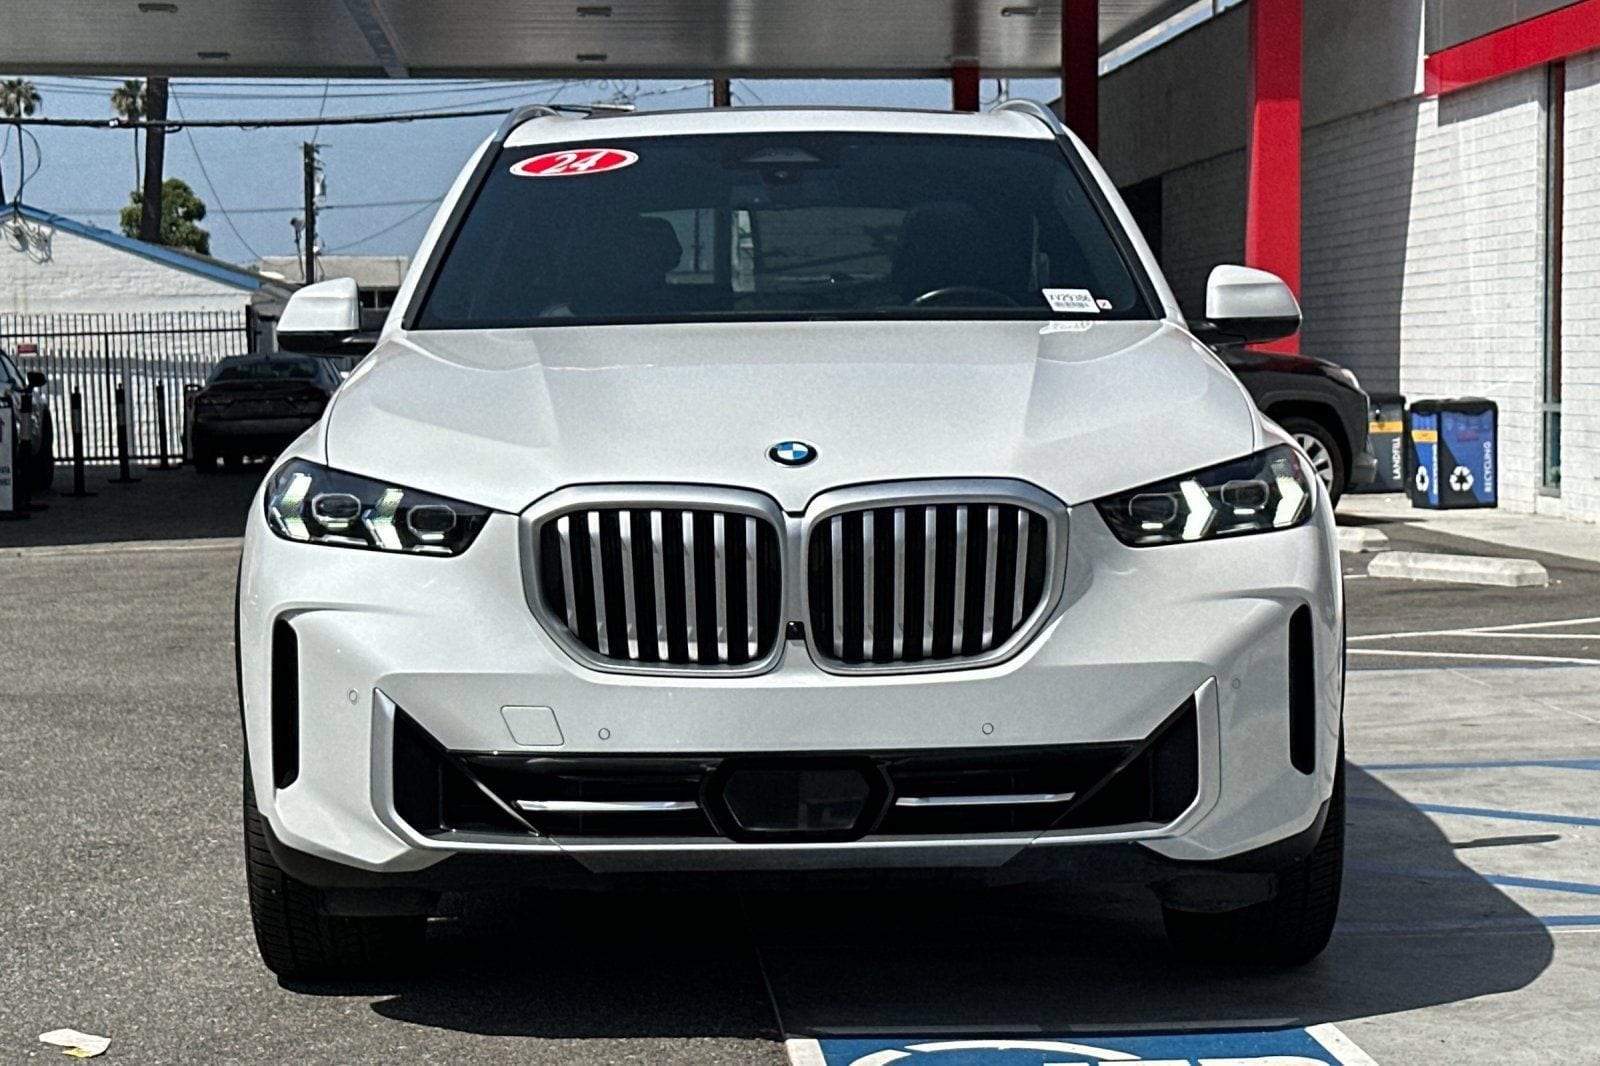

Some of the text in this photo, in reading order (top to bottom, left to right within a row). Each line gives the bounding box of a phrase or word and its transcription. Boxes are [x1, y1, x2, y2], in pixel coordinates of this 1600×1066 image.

[543, 151, 607, 174] 24
[1392, 437, 1401, 480] LANDFILL
[1483, 441, 1492, 493] RECYCLING
